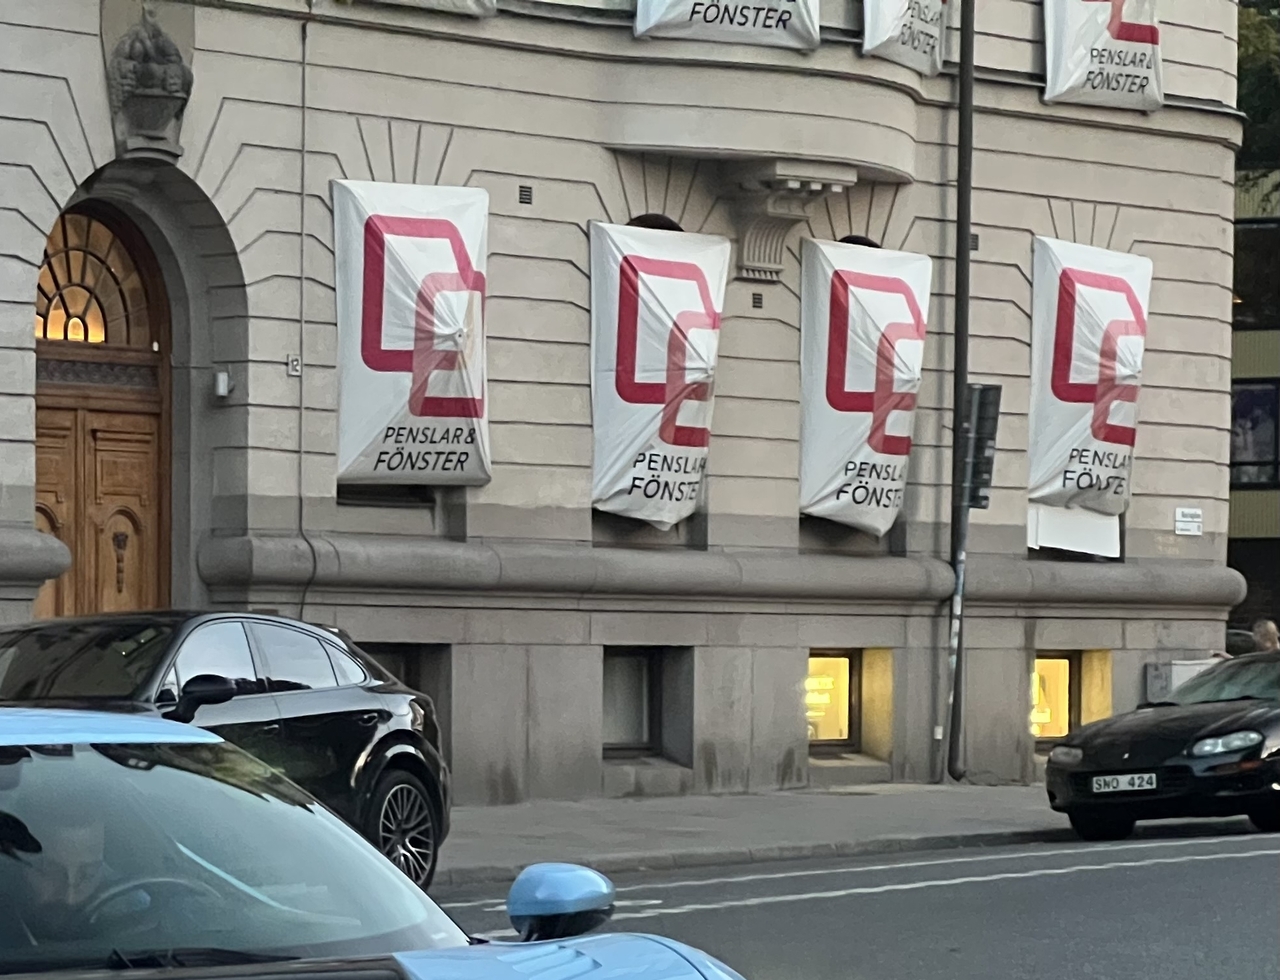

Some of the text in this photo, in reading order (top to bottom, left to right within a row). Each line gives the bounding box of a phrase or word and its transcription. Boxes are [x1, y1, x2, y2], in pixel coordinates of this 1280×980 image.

[1082, 67, 1149, 94] FÖNSTER
[373, 446, 469, 471] FÖNSTER
[1128, 775, 1154, 788] 424
